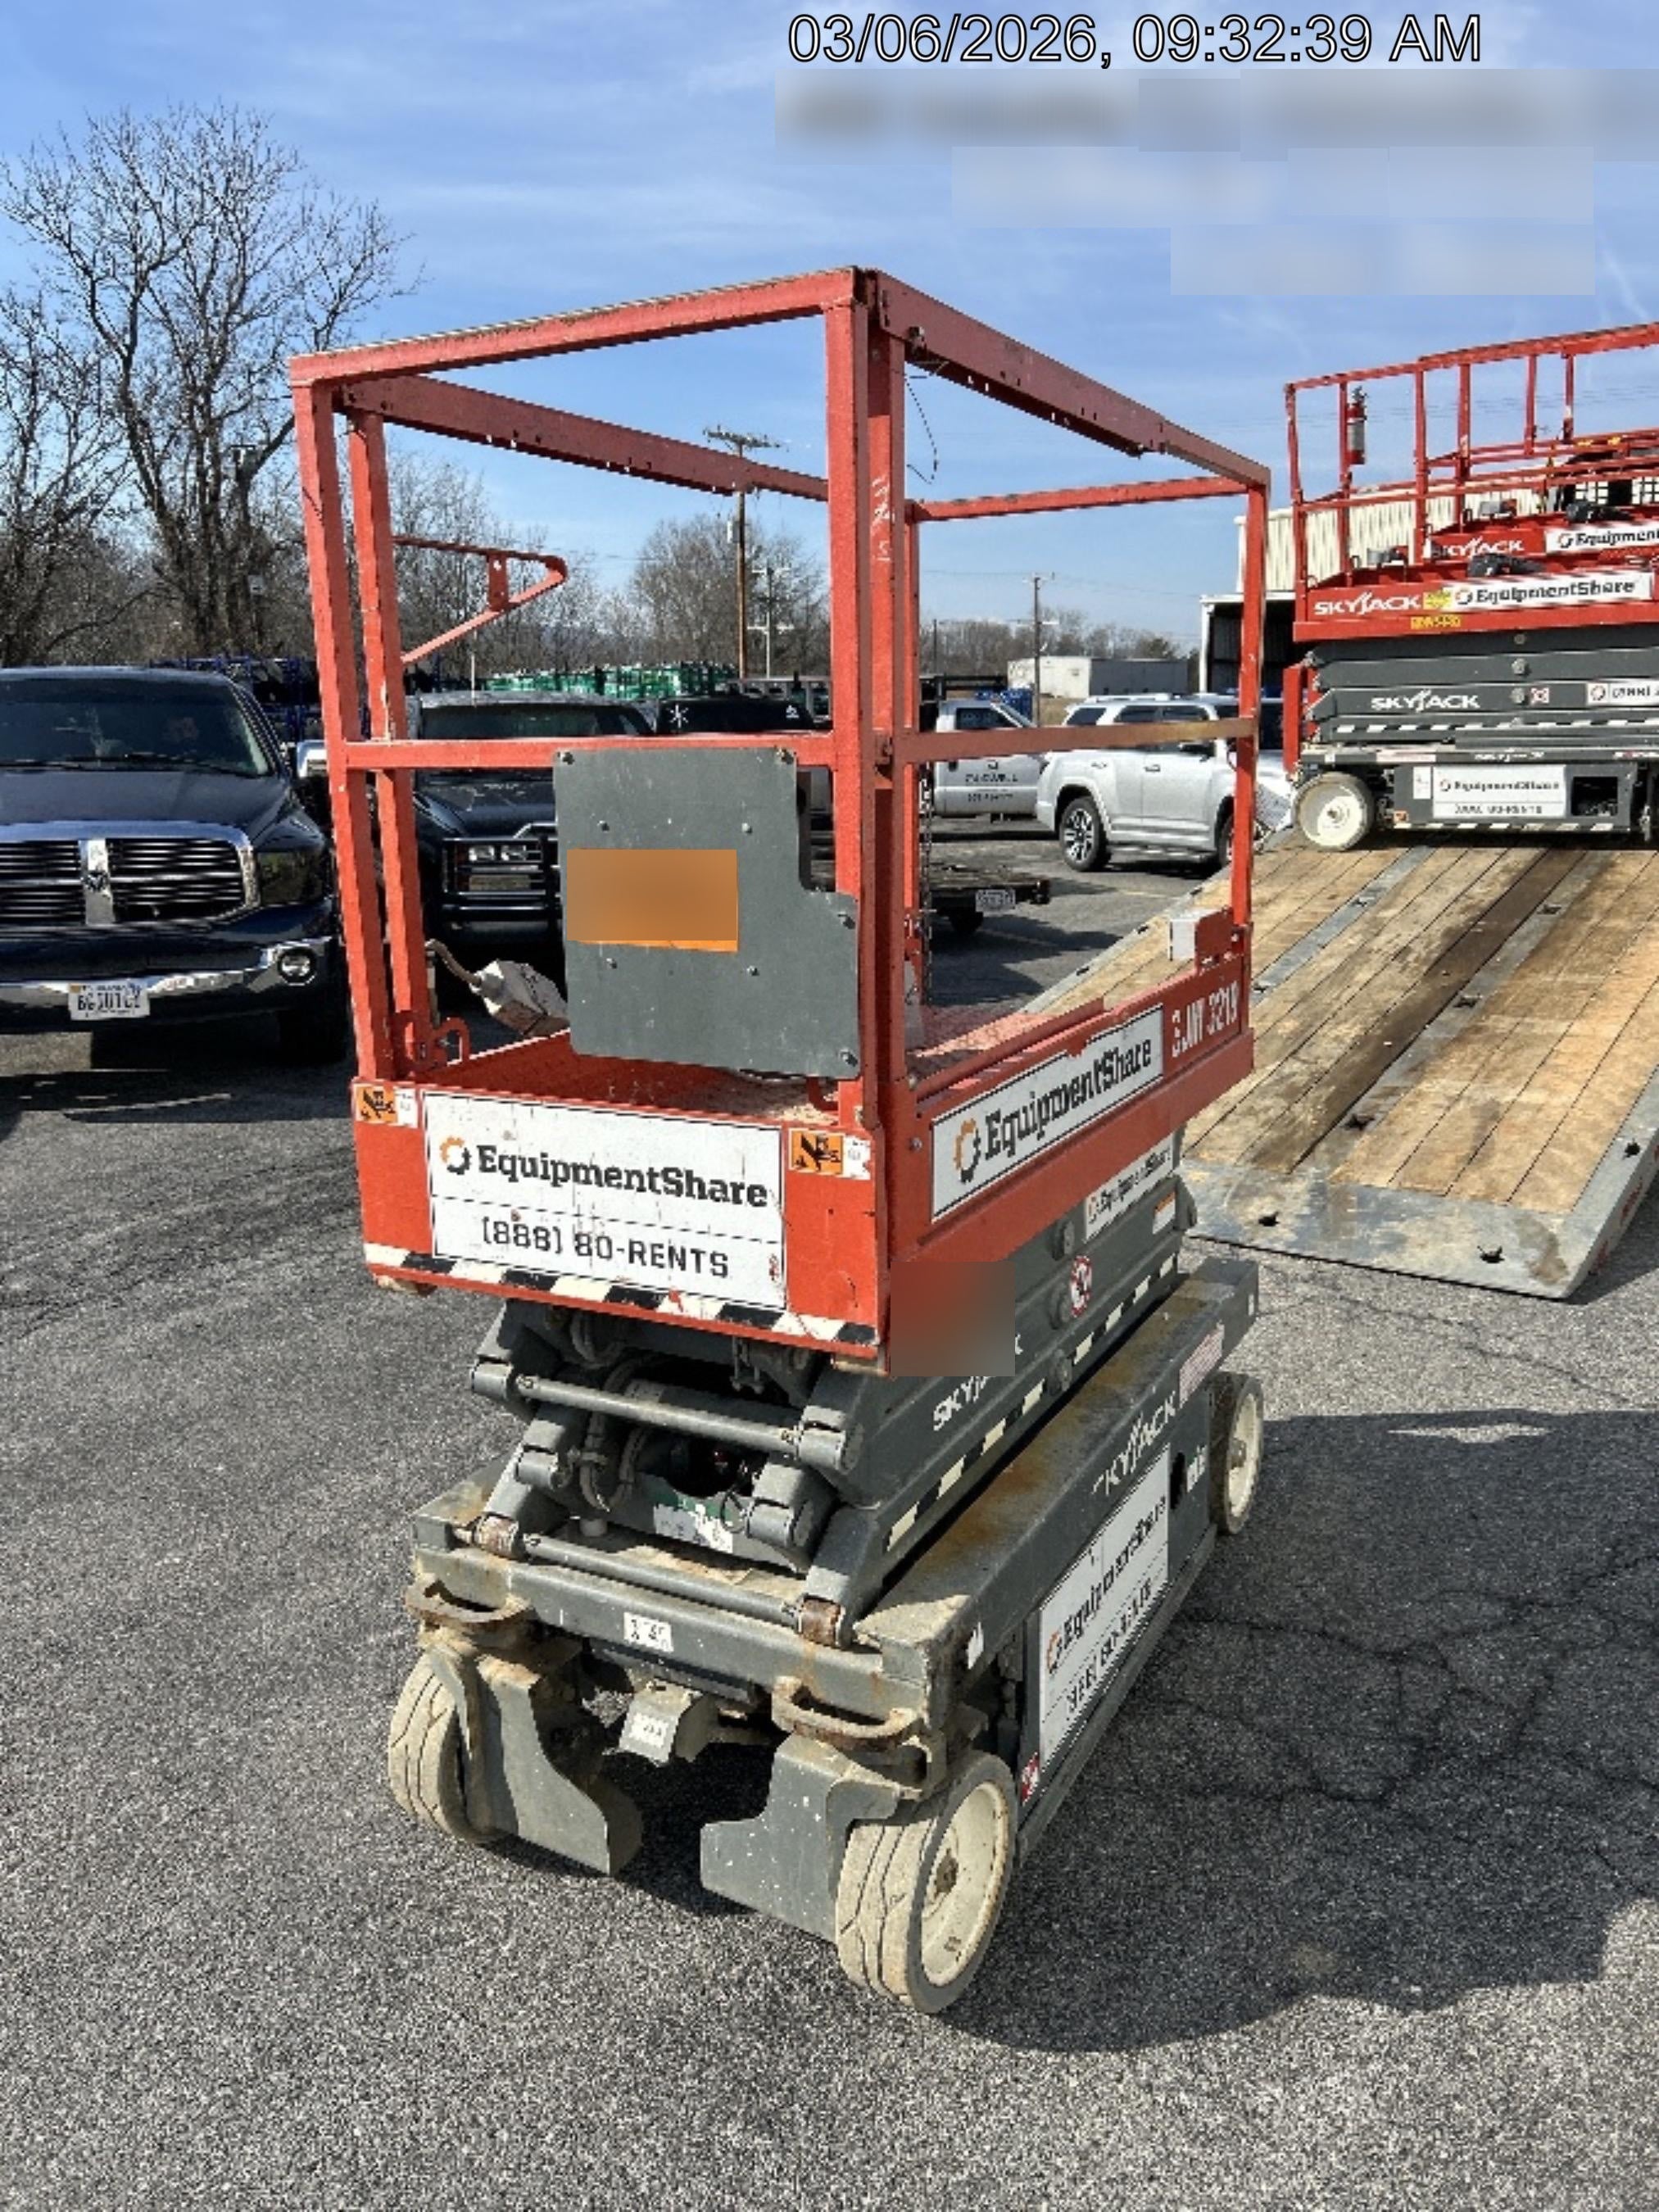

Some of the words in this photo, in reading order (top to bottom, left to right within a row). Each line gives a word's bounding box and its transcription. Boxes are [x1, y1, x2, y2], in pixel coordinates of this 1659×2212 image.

[1314, 592, 1423, 615] SKYJACK
[1476, 581, 1636, 605] EquipmentShare
[1371, 689, 1480, 712] SKYJACK
[985, 1038, 1152, 1158] EquipmentShare
[476, 1145, 768, 1208] EquipmentShare
[482, 1216, 563, 1254] (888)
[573, 1226, 728, 1278] 80-RENTS
